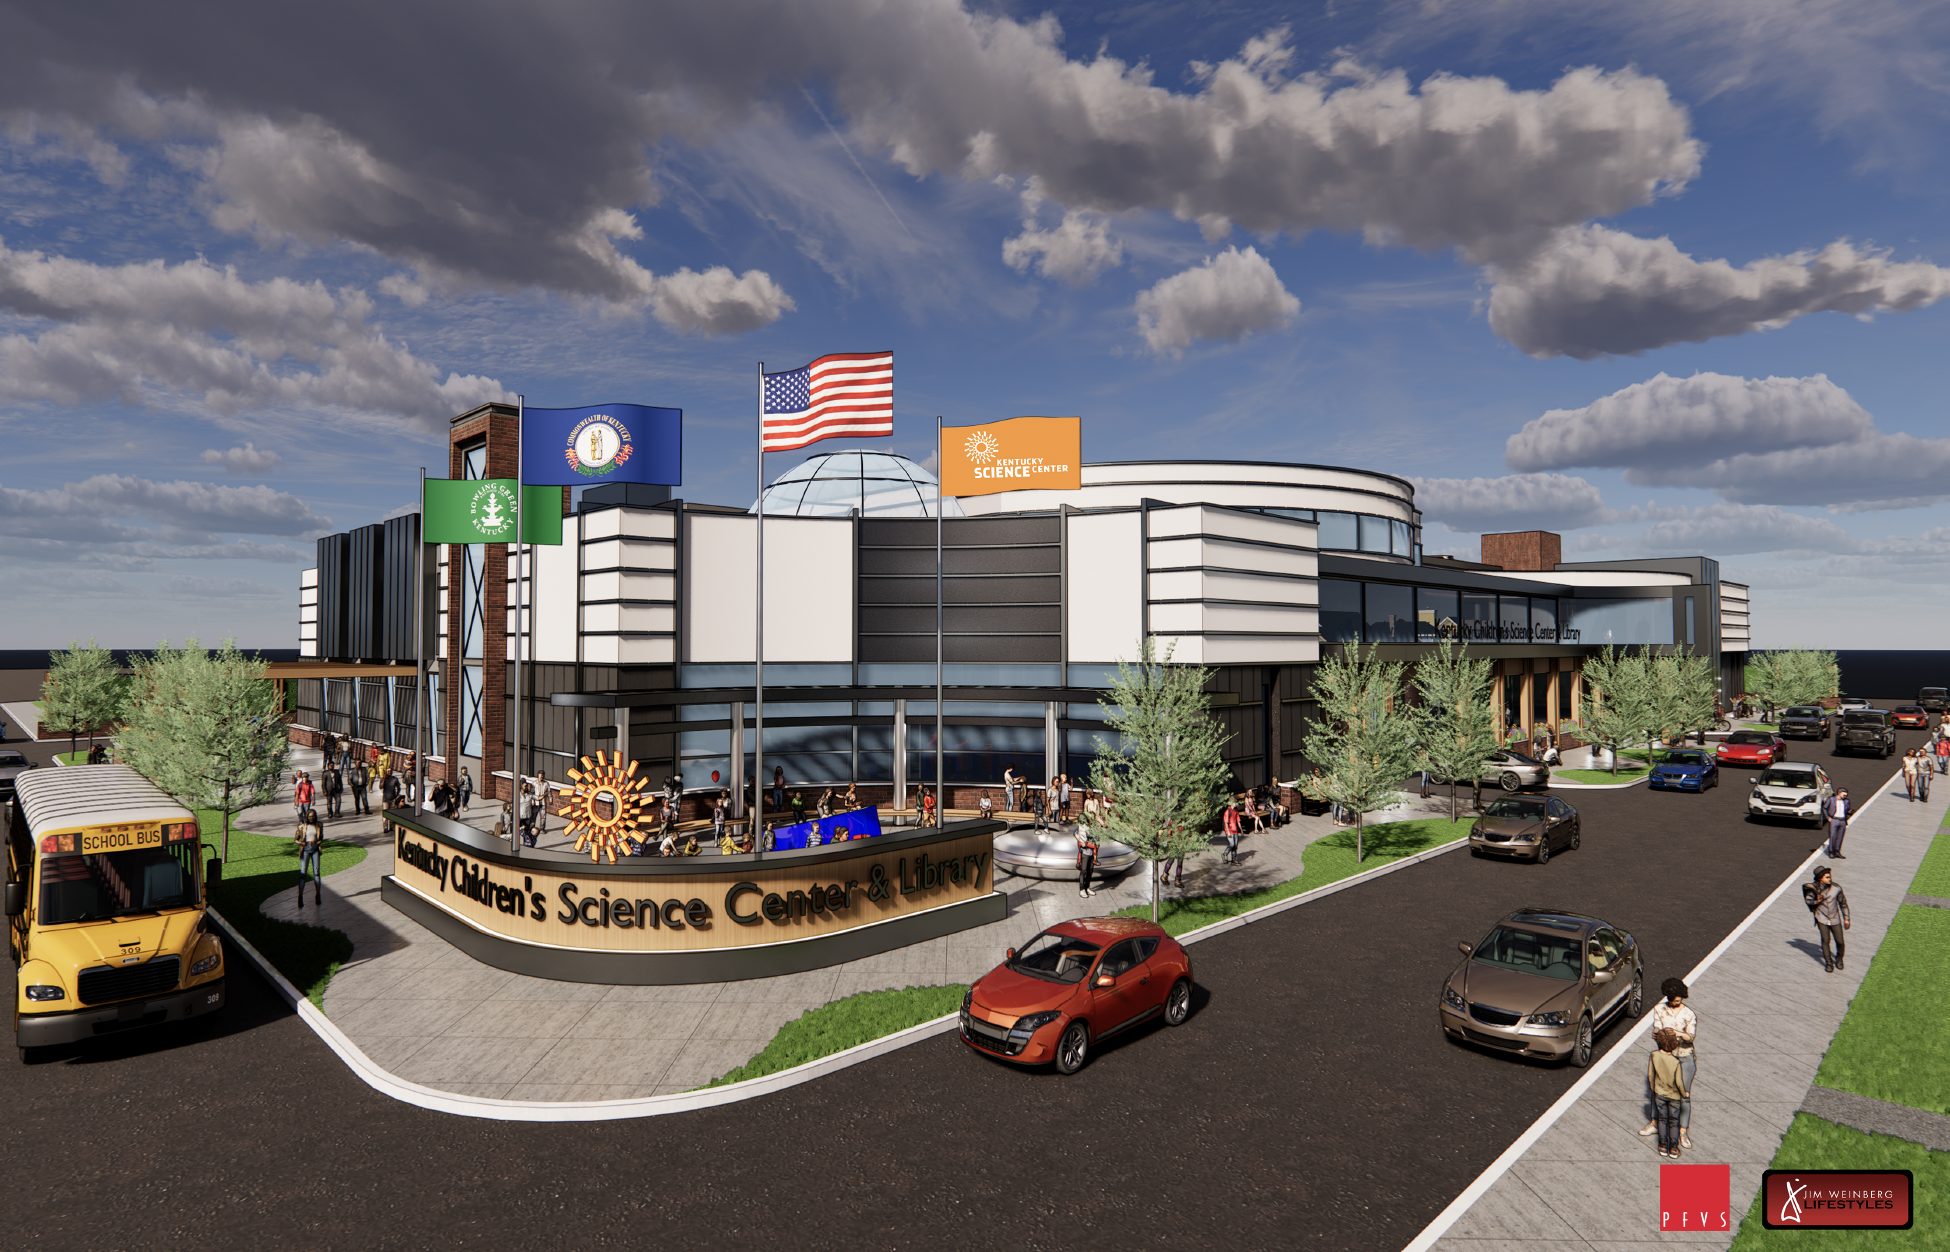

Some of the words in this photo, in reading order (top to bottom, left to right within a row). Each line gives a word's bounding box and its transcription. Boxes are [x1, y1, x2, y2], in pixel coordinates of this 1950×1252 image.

[567, 414, 601, 446] COMMONWEALTH
[608, 416, 632, 442] KENTUCKY
[974, 466, 1030, 478] SCIENCE
[1032, 465, 1068, 473] CENTER
[997, 458, 1044, 467] KENTUCKY
[470, 483, 497, 514] BOWLING
[499, 485, 518, 513] GREEN
[472, 518, 514, 535] KENTUCKY
[83, 833, 133, 850] SCHOOL
[137, 830, 160, 845] BUS
[398, 827, 449, 892] Kentucky
[451, 855, 547, 922] Children's
[558, 882, 709, 928] Science
[725, 881, 859, 924] Center
[868, 864, 890, 902] &
[900, 852, 989, 896] Library
[120, 946, 141, 955] 309
